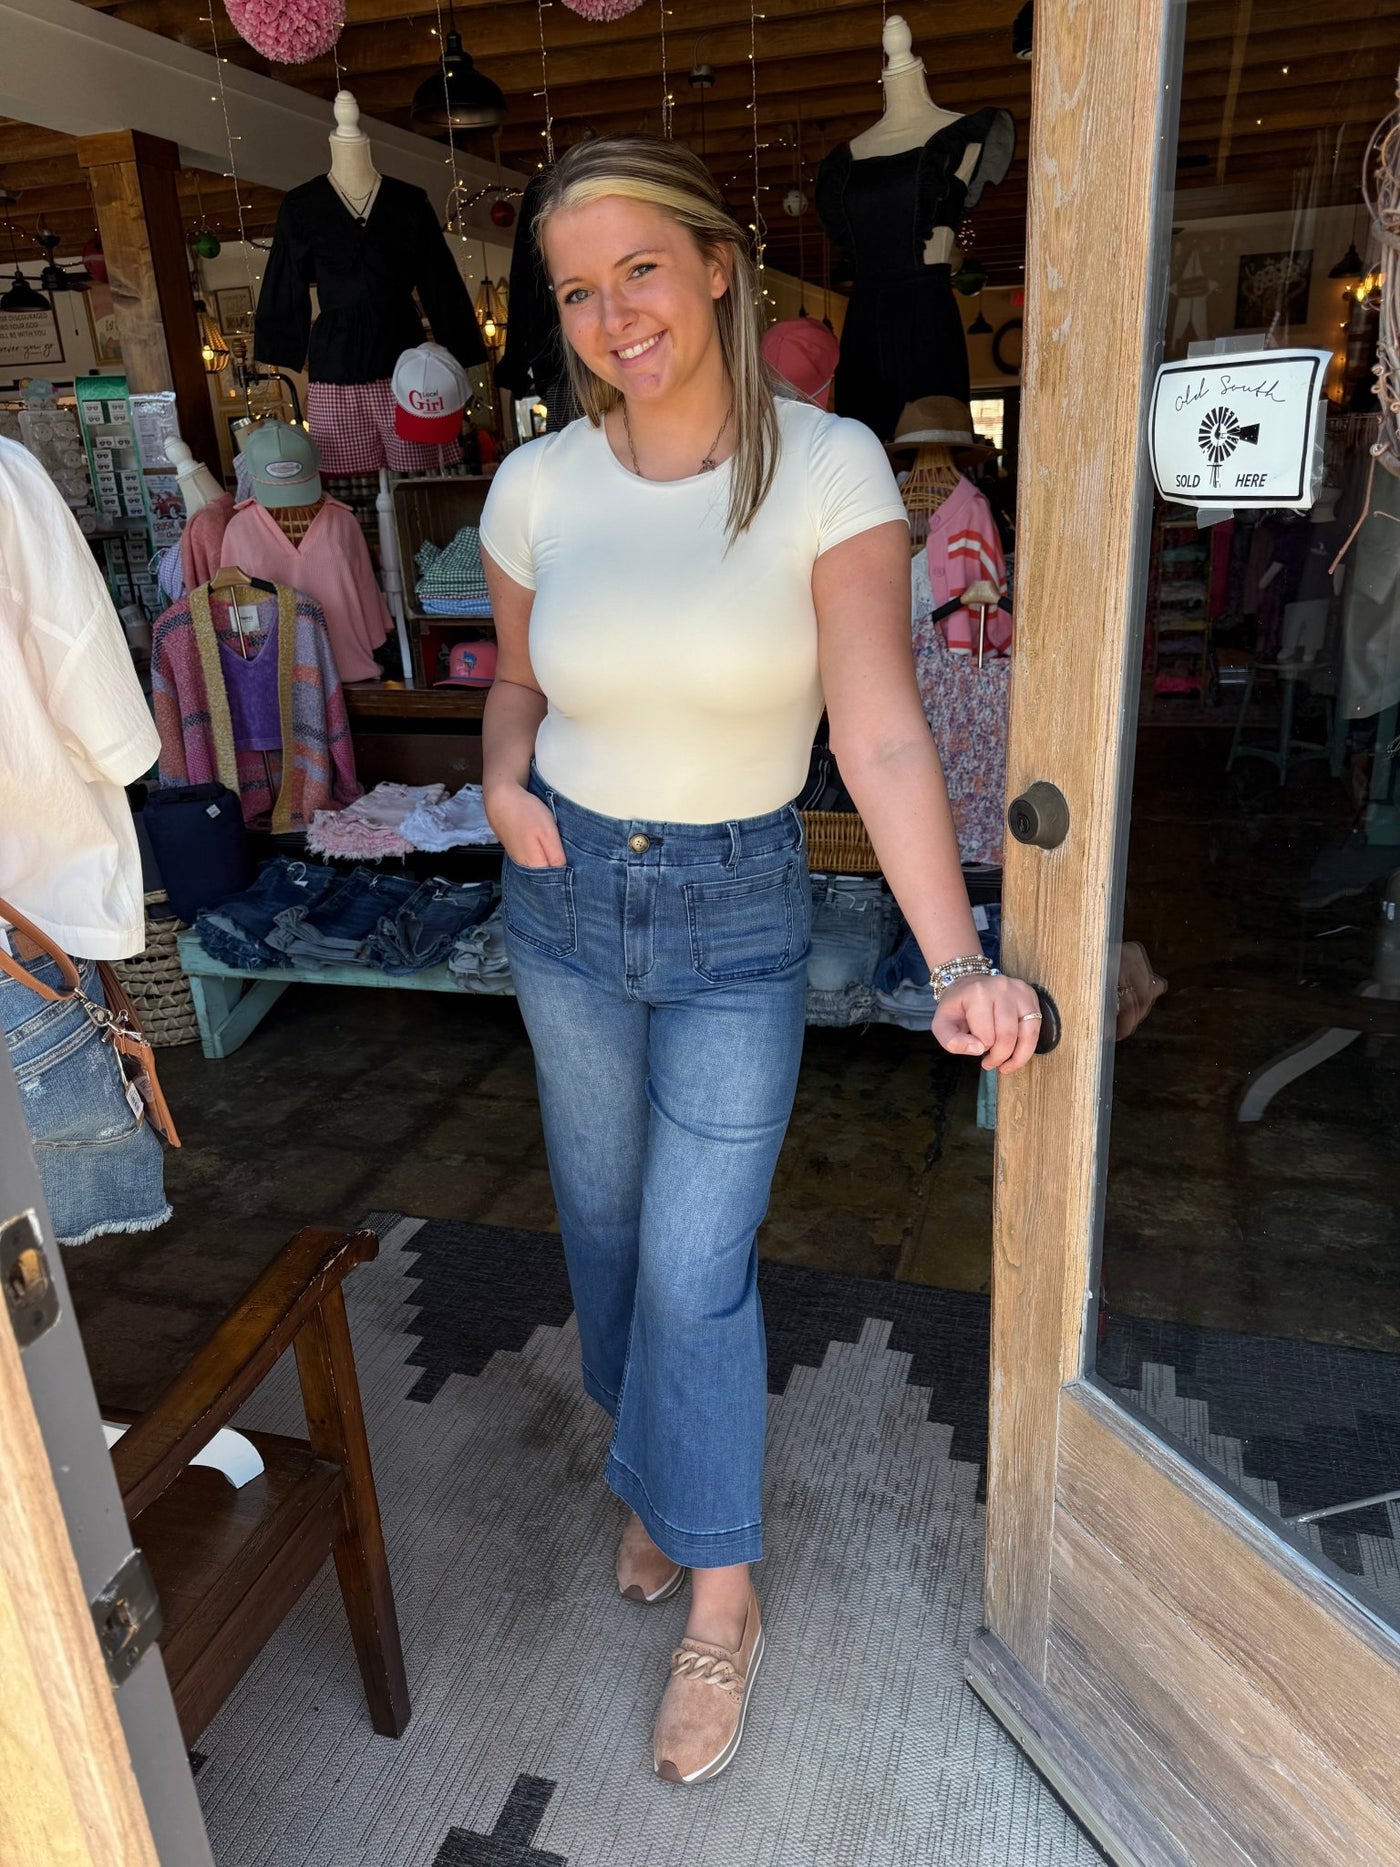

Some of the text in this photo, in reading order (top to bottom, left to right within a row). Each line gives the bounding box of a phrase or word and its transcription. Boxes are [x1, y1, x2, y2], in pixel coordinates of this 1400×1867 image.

[43, 343, 54, 358] go
[422, 389, 438, 398] Local
[1220, 375, 1286, 402] South
[408, 389, 445, 412] Girl
[1175, 473, 1268, 488] SOLD HERE
